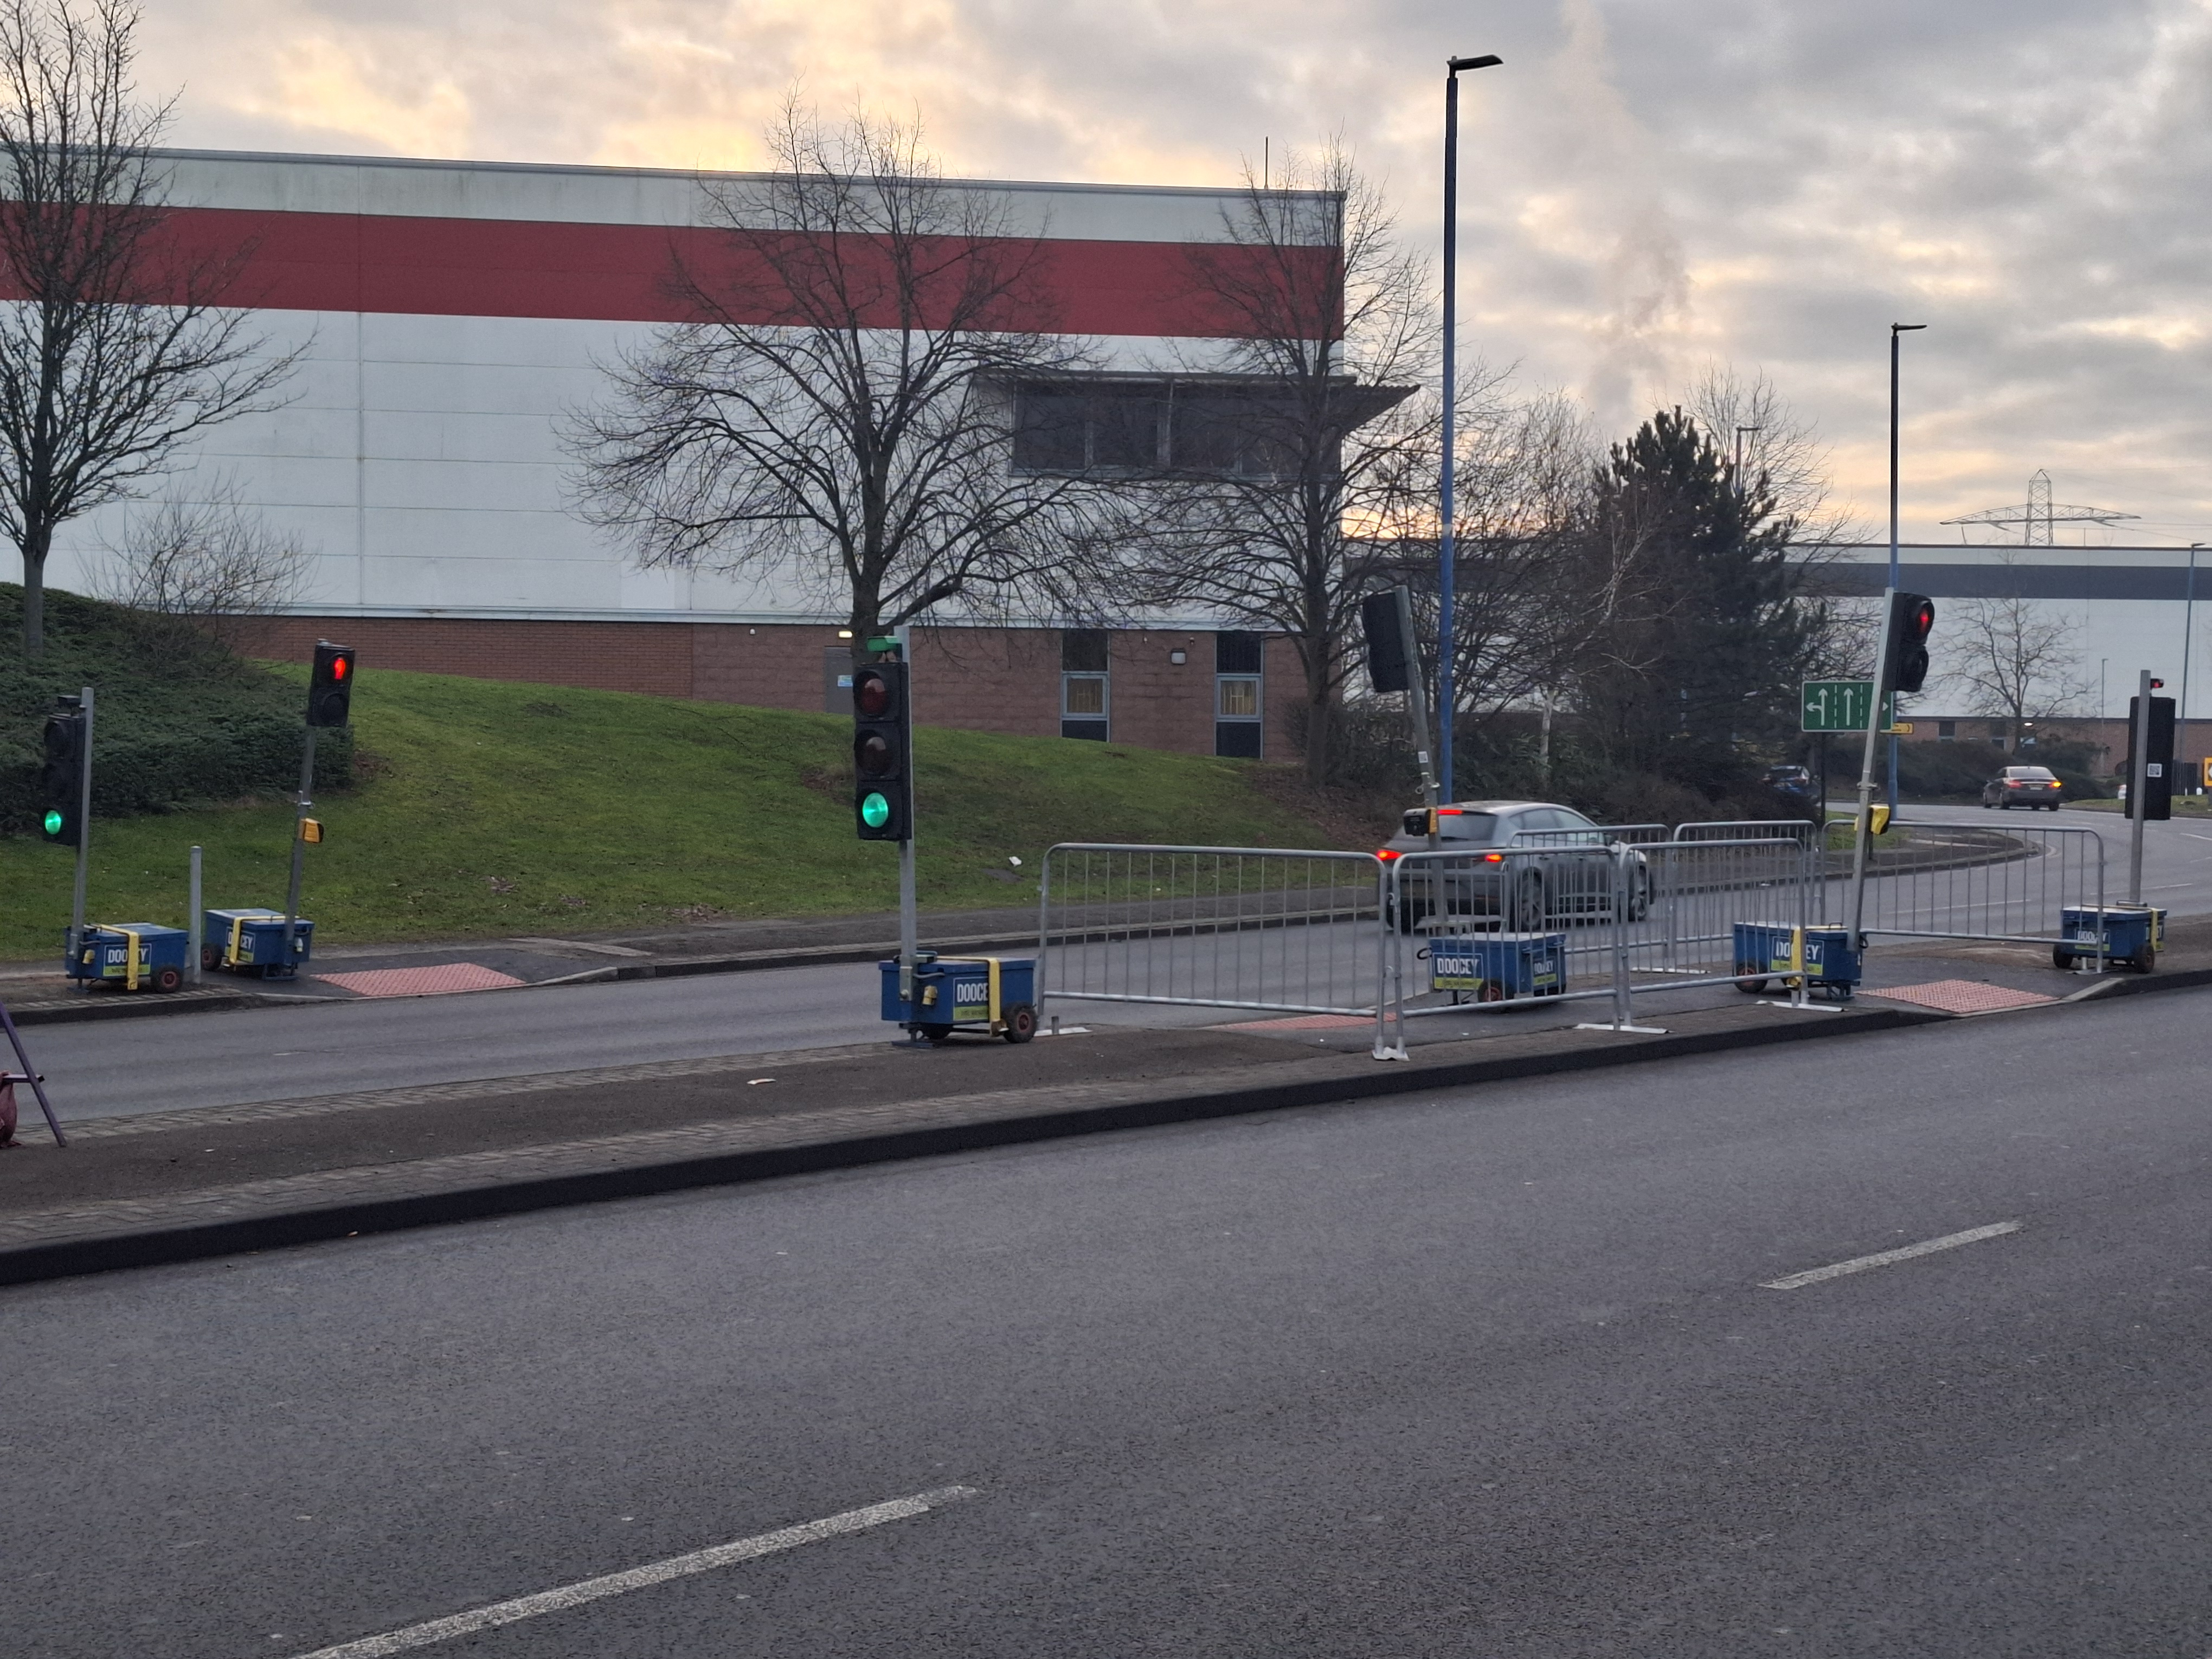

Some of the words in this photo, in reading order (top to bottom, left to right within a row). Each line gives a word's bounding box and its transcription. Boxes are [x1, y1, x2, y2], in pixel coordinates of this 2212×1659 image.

[108, 948, 149, 963] DOOY
[1776, 941, 1821, 960] DOEY
[1437, 957, 1480, 974] DOOCEY
[957, 982, 988, 1002] DOOCE
